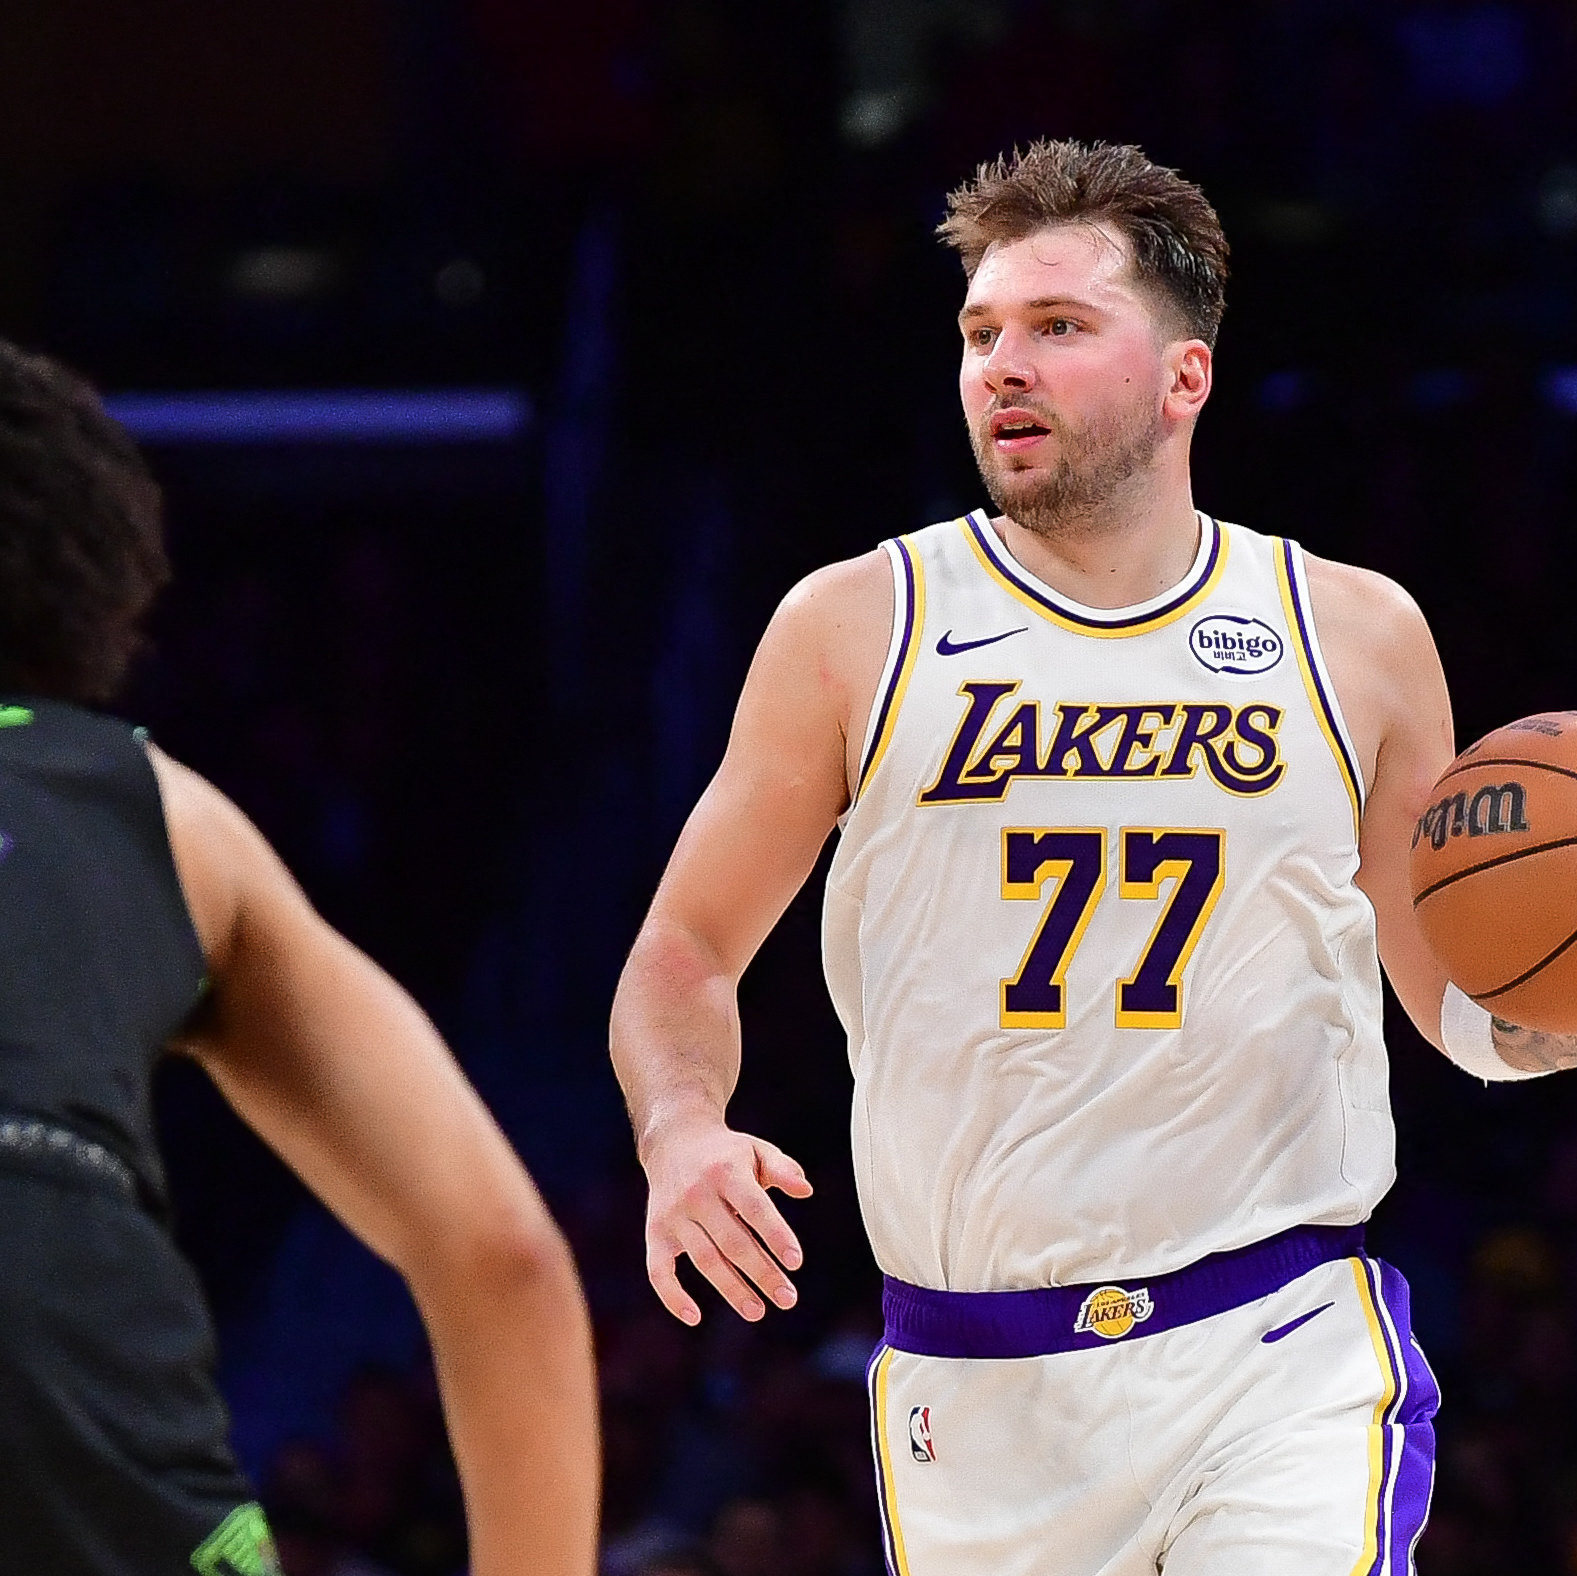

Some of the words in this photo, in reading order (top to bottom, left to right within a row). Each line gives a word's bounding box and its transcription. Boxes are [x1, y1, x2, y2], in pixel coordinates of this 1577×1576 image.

[1197, 629, 1278, 658] bibigo
[1213, 651, 1247, 661] 비비고
[916, 679, 1288, 807] LAKERS
[999, 827, 1227, 1030] 77
[1077, 1300, 1151, 1330] LAKERS
